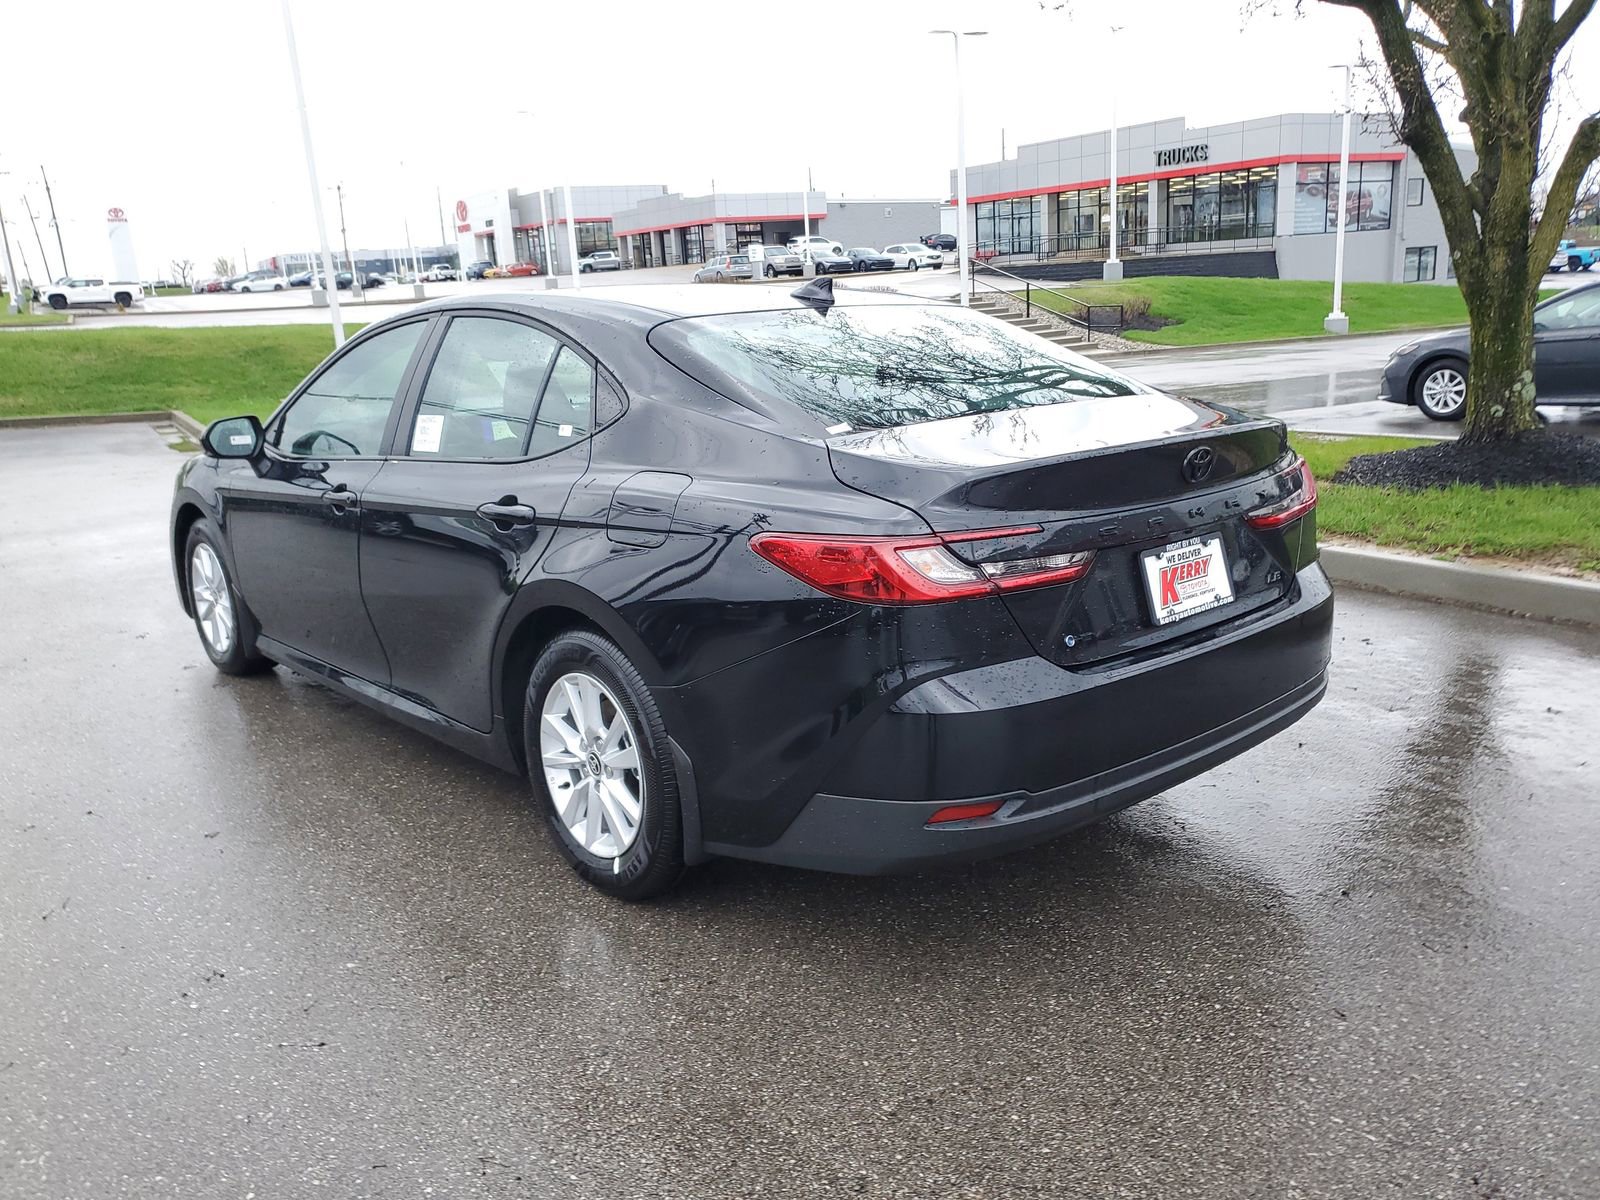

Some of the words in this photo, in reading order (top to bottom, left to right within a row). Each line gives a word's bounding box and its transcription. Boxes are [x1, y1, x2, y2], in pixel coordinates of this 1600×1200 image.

[1153, 144, 1208, 166] TRUCKS
[1166, 541, 1182, 552] RIGHT
[1166, 555, 1176, 564] WE
[1177, 548, 1202, 562] DELIVER
[1160, 556, 1211, 608] KERRY
[1267, 570, 1281, 584] LE
[1188, 579, 1208, 591] TOYOTA
